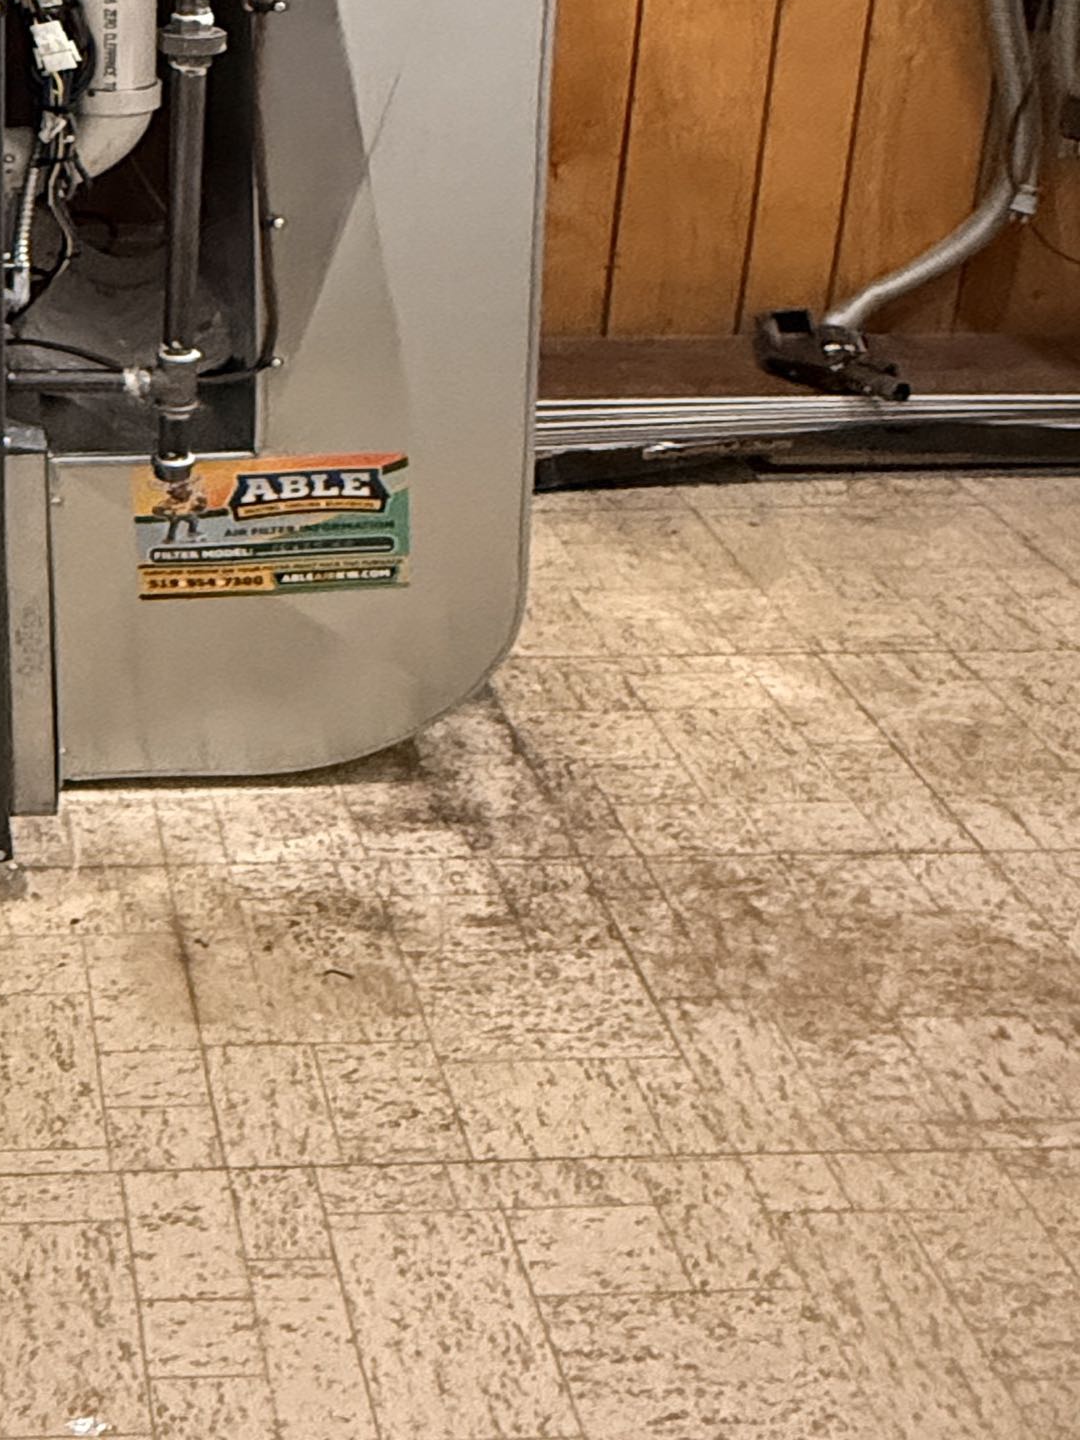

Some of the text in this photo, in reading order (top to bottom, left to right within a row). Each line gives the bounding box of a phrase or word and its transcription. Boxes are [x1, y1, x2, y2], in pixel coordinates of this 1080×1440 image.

[104, 9, 118, 29] ZERO
[103, 33, 118, 77] CLEARANCE
[240, 472, 370, 504] ABLE
[224, 520, 395, 537] AIR FILTER INFORMATION
